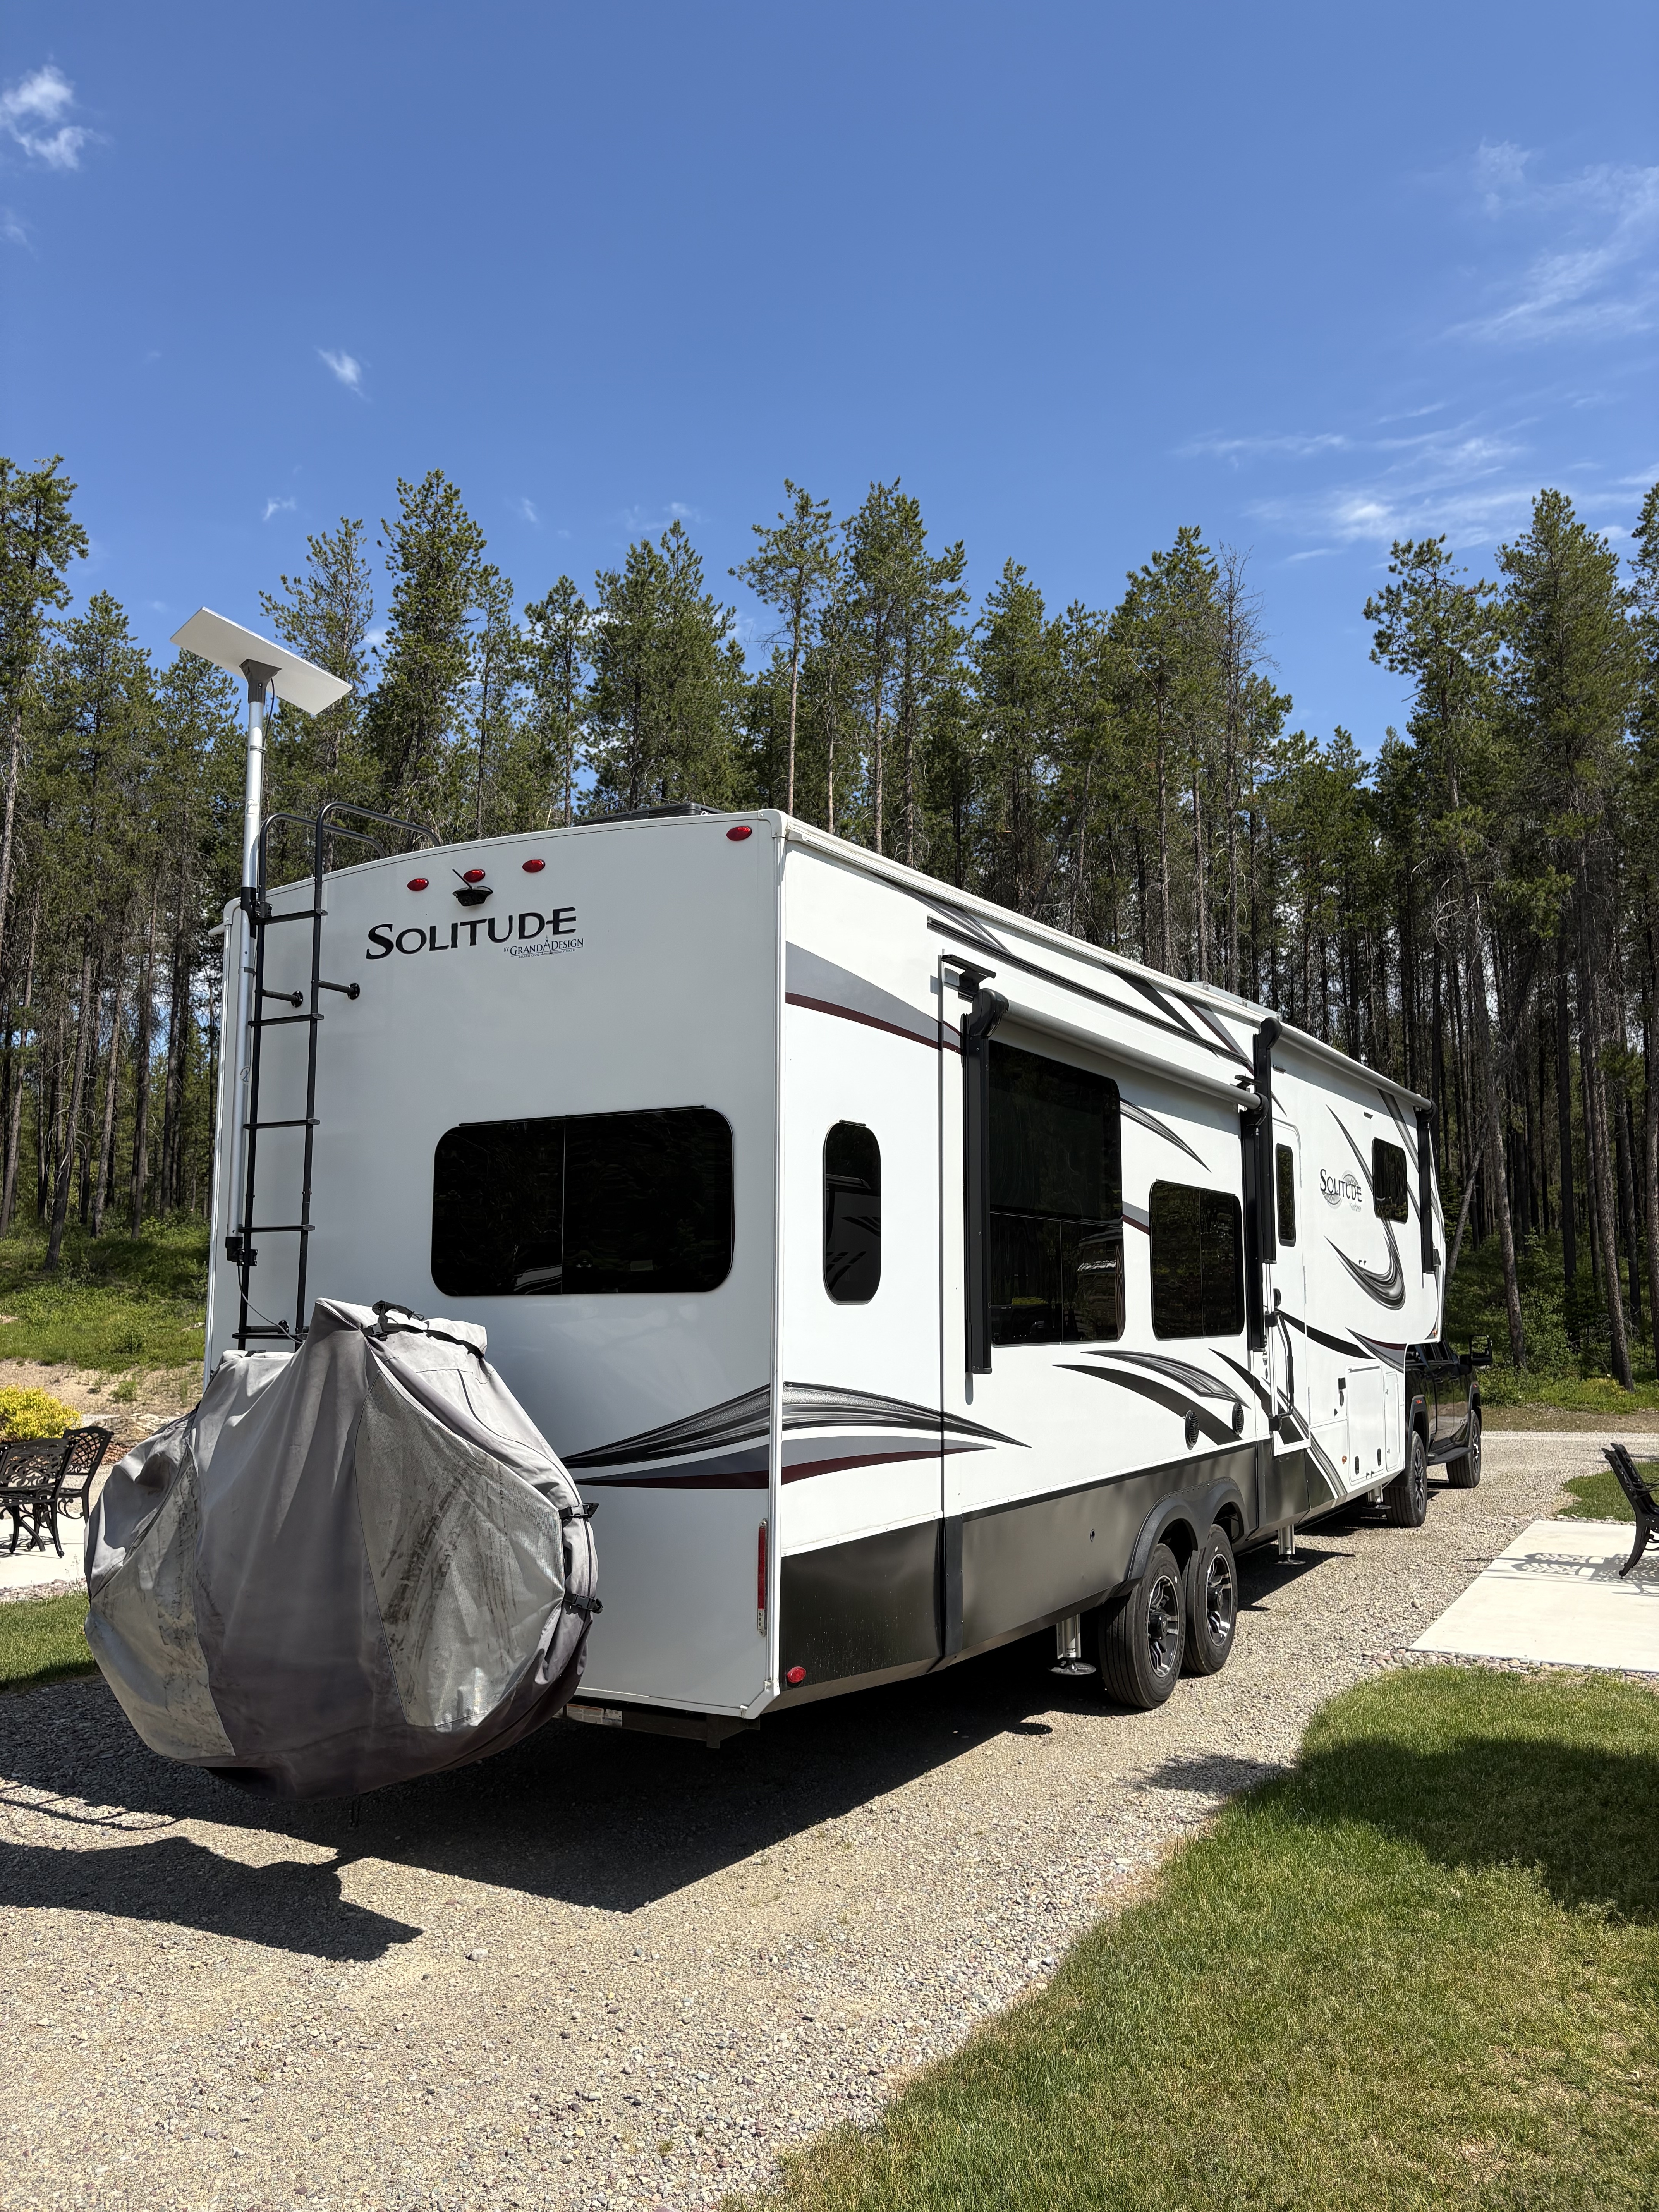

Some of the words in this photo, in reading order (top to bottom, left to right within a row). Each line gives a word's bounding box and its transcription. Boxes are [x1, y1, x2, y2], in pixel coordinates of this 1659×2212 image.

[366, 907, 577, 960] SOLITUDE
[510, 944, 543, 955] GRAND
[551, 938, 584, 950] DESIGN
[1320, 1169, 1362, 1202] SOLITUDE
